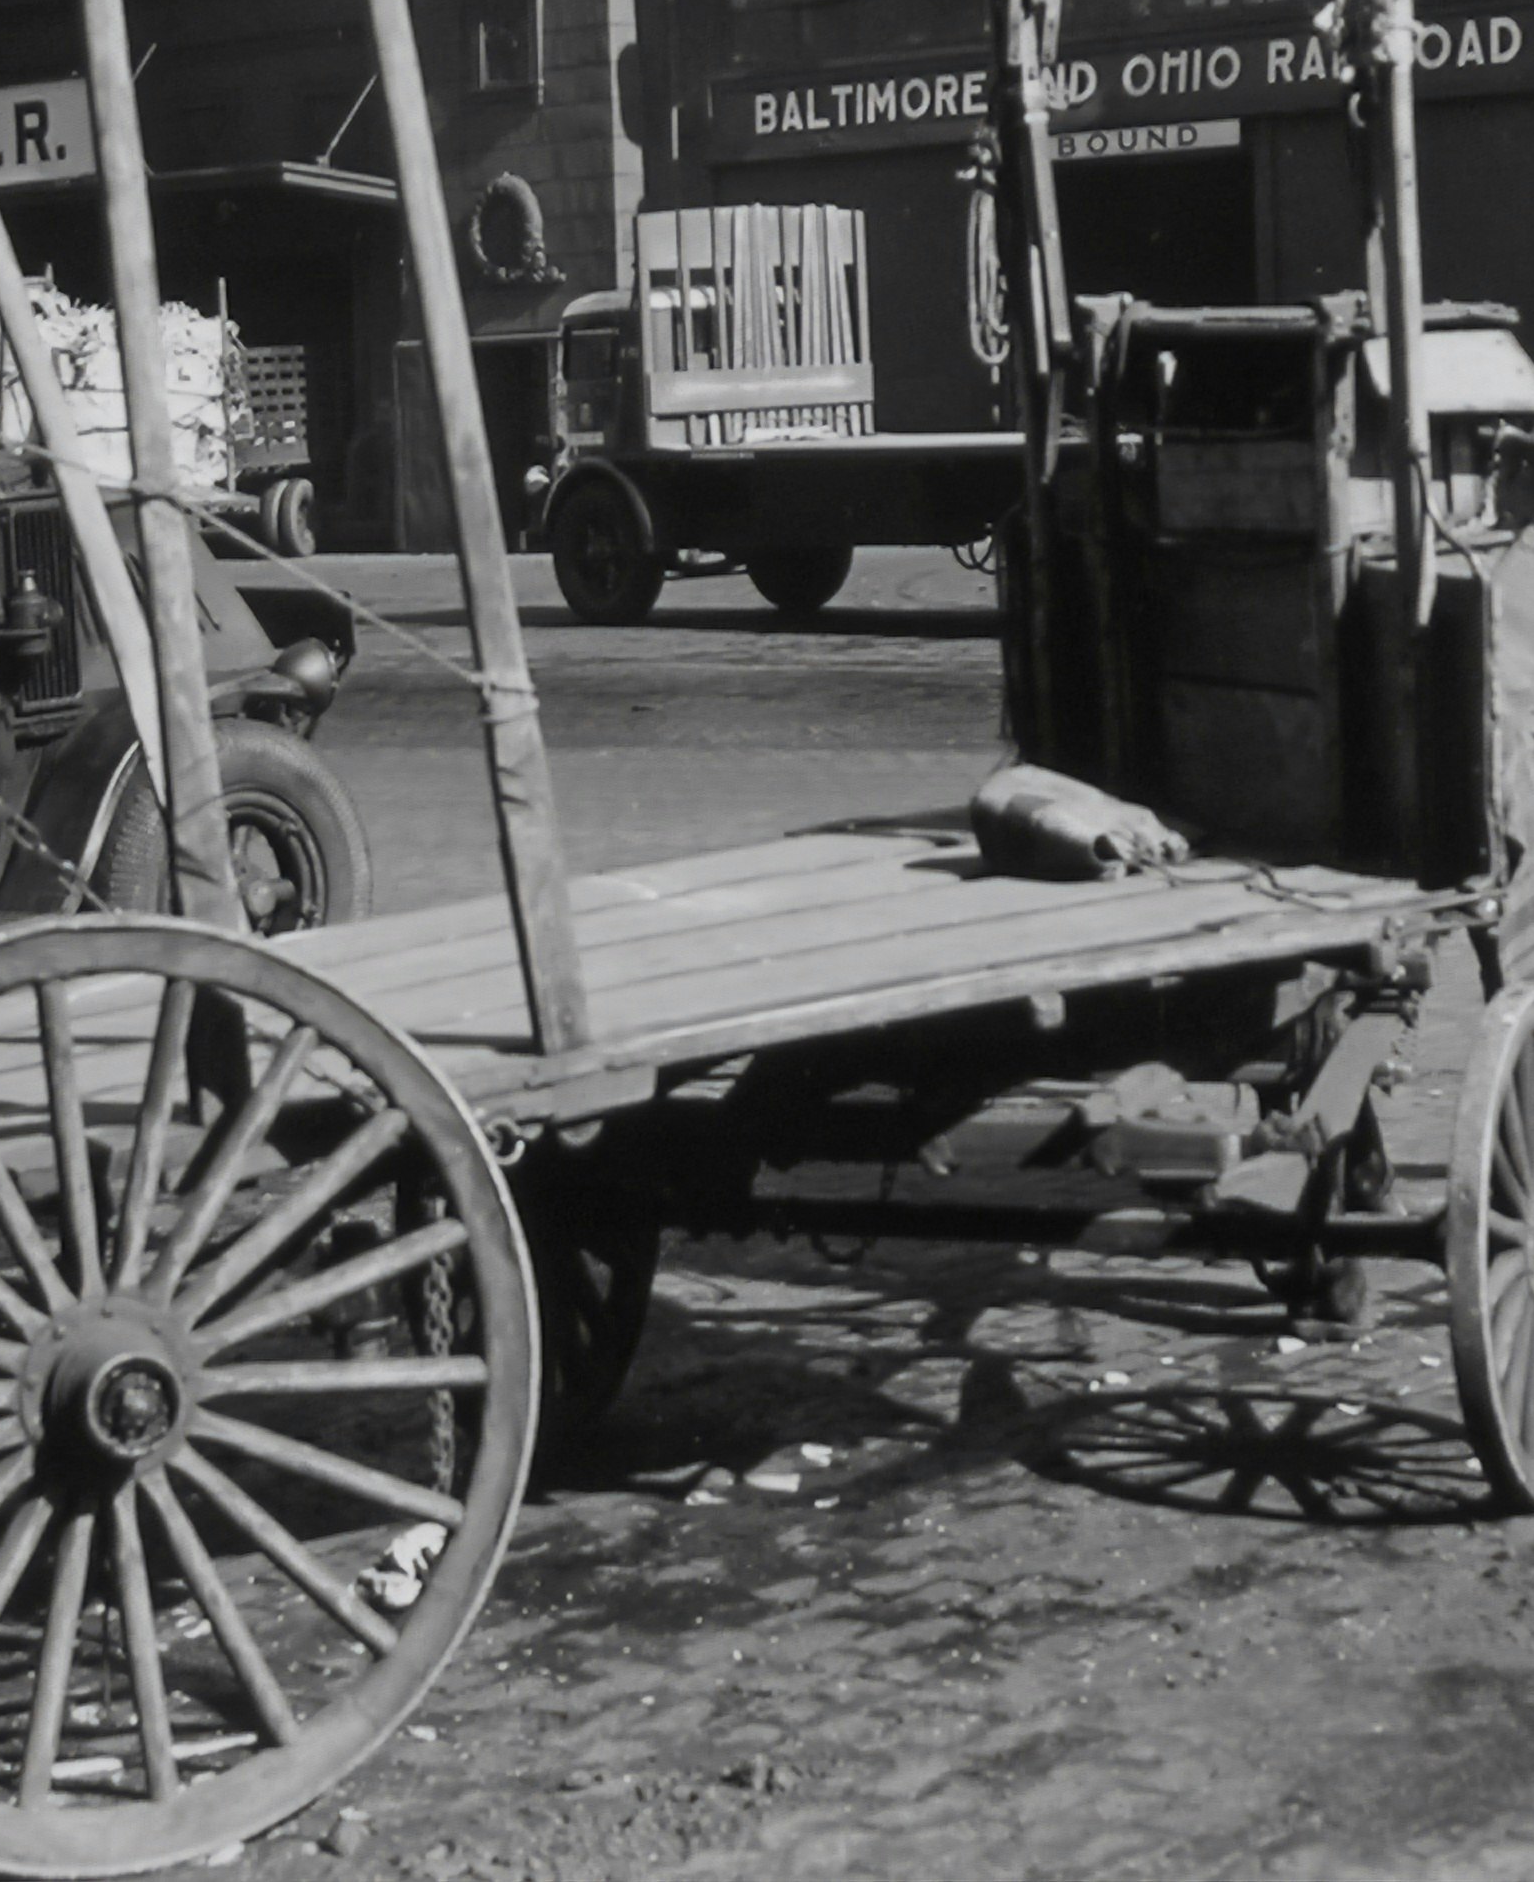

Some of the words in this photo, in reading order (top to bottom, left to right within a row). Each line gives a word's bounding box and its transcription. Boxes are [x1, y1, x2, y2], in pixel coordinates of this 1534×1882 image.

[754, 70, 989, 136] BALTIMORE
[1041, 60, 1098, 111] ND
[1121, 45, 1242, 98] OHIO
[1266, 15, 1523, 85] RAIOAD
[1057, 122, 1199, 158] BOUND
